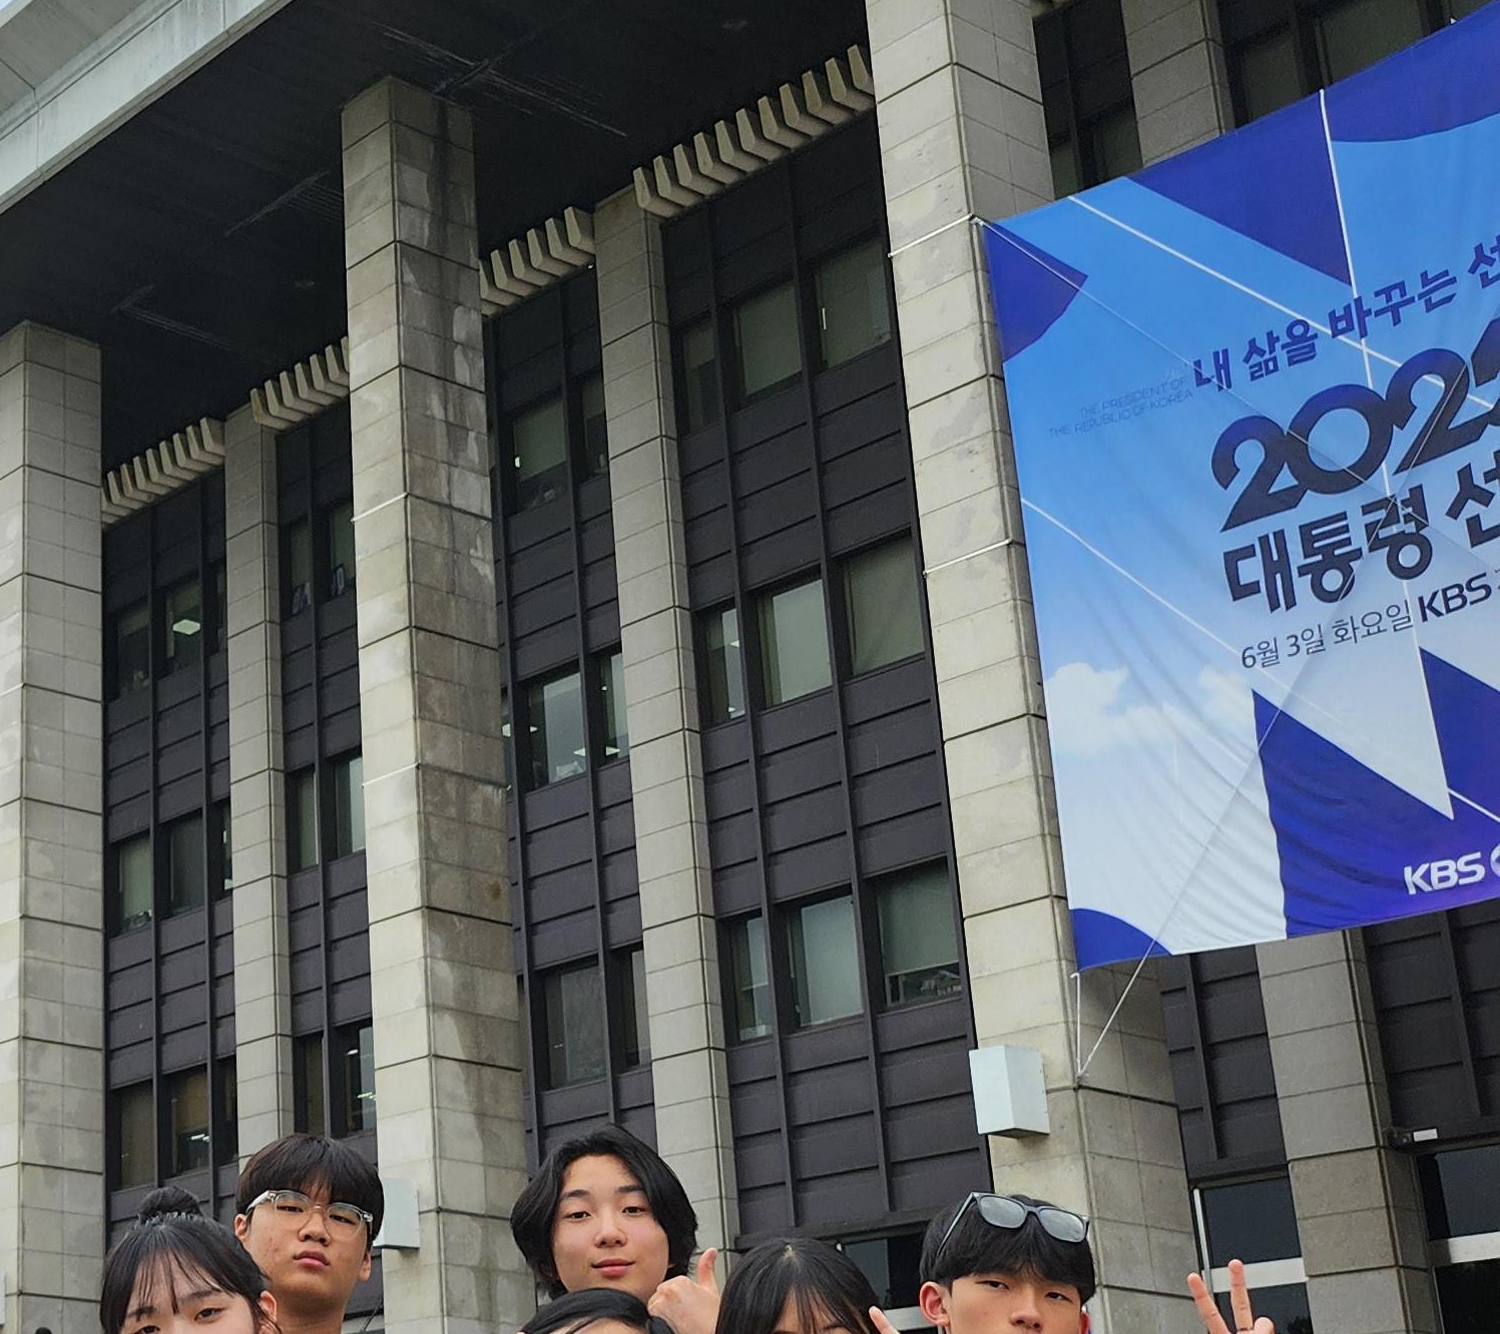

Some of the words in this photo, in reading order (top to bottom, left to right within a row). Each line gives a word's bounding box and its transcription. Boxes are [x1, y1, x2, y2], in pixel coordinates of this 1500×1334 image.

[1193, 348, 1232, 392] 내
[1242, 319, 1318, 382] 삶을
[1328, 270, 1457, 340] 바꾸는
[1223, 484, 1433, 614] 대통령
[1241, 637, 1281, 669] 6월
[1286, 623, 1327, 656] 3일
[1331, 599, 1414, 644] 화요일
[1418, 571, 1493, 623] KBS
[1404, 851, 1485, 896] KBS
